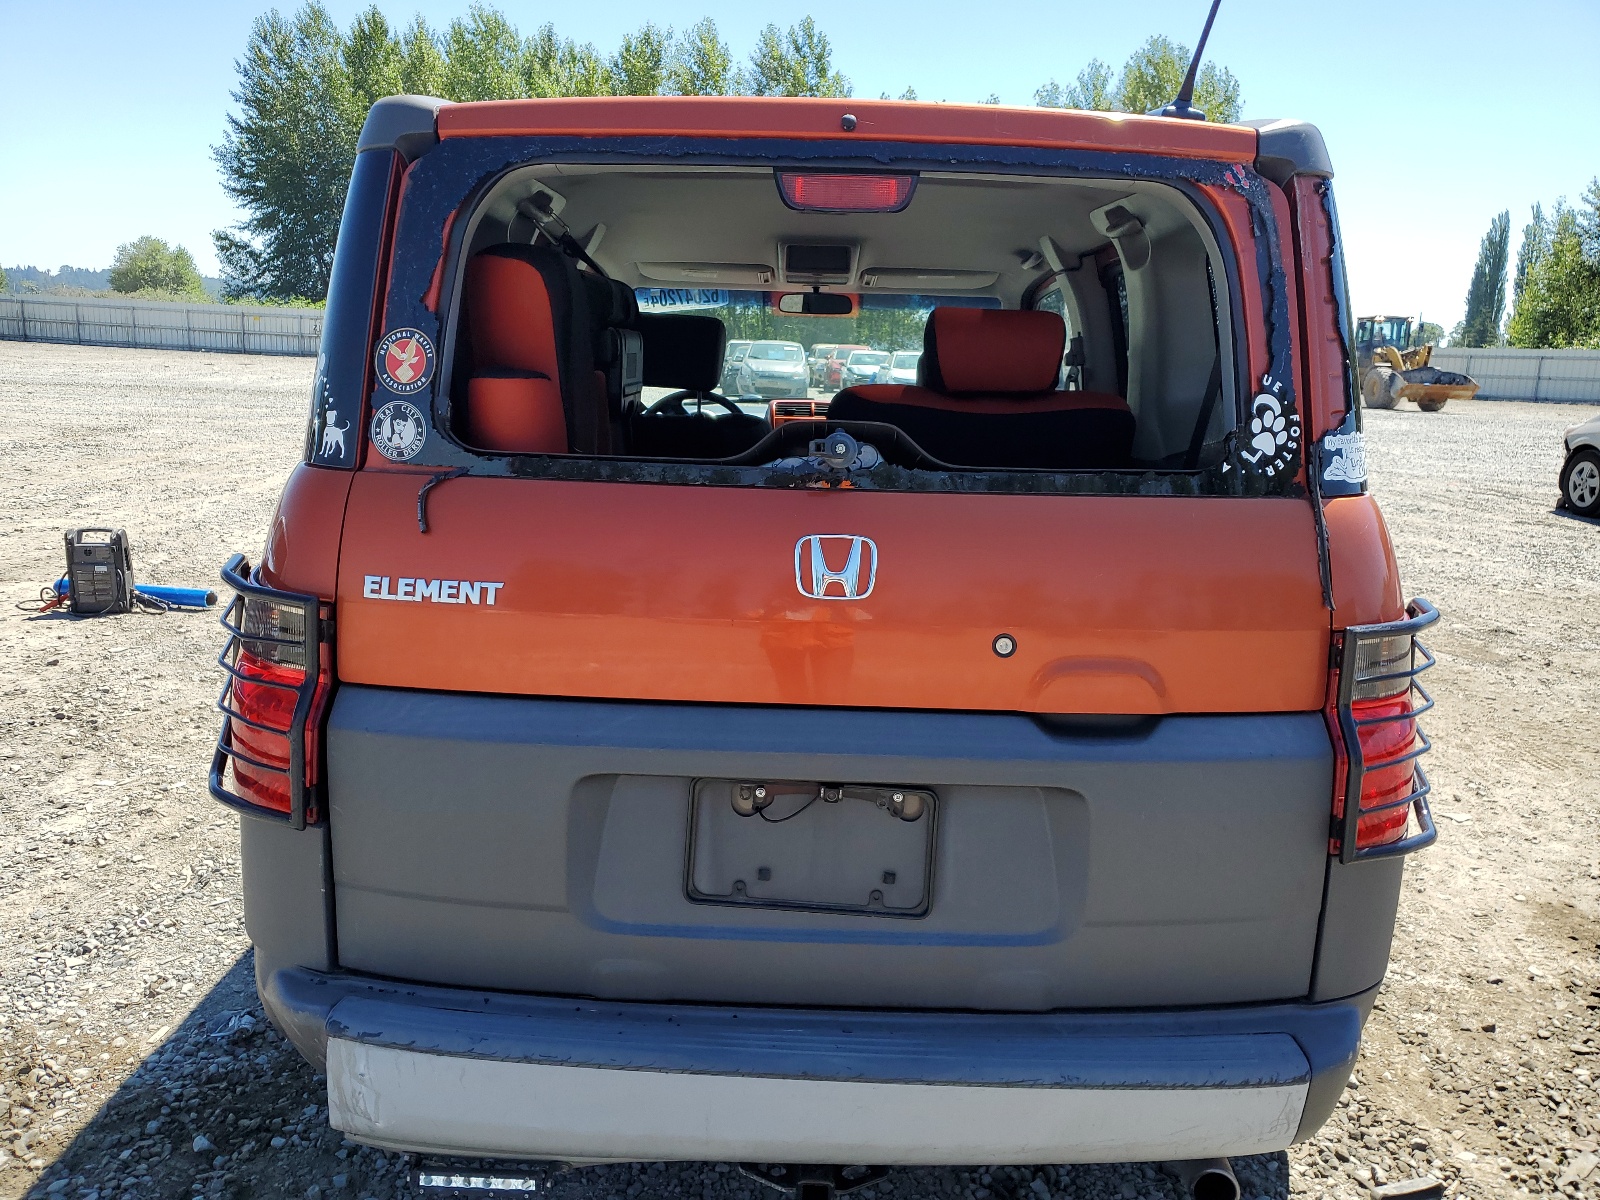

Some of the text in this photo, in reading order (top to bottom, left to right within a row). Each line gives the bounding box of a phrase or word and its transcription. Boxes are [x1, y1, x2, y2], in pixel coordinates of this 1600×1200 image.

[379, 331, 433, 391] NATIONAL WAFFLE ASSOCIATION
[380, 405, 421, 420] RAT CITY
[375, 434, 423, 458] ROLLER DERBY
[1265, 414, 1300, 476] FOSTER
[363, 575, 505, 606] ELEMENT
